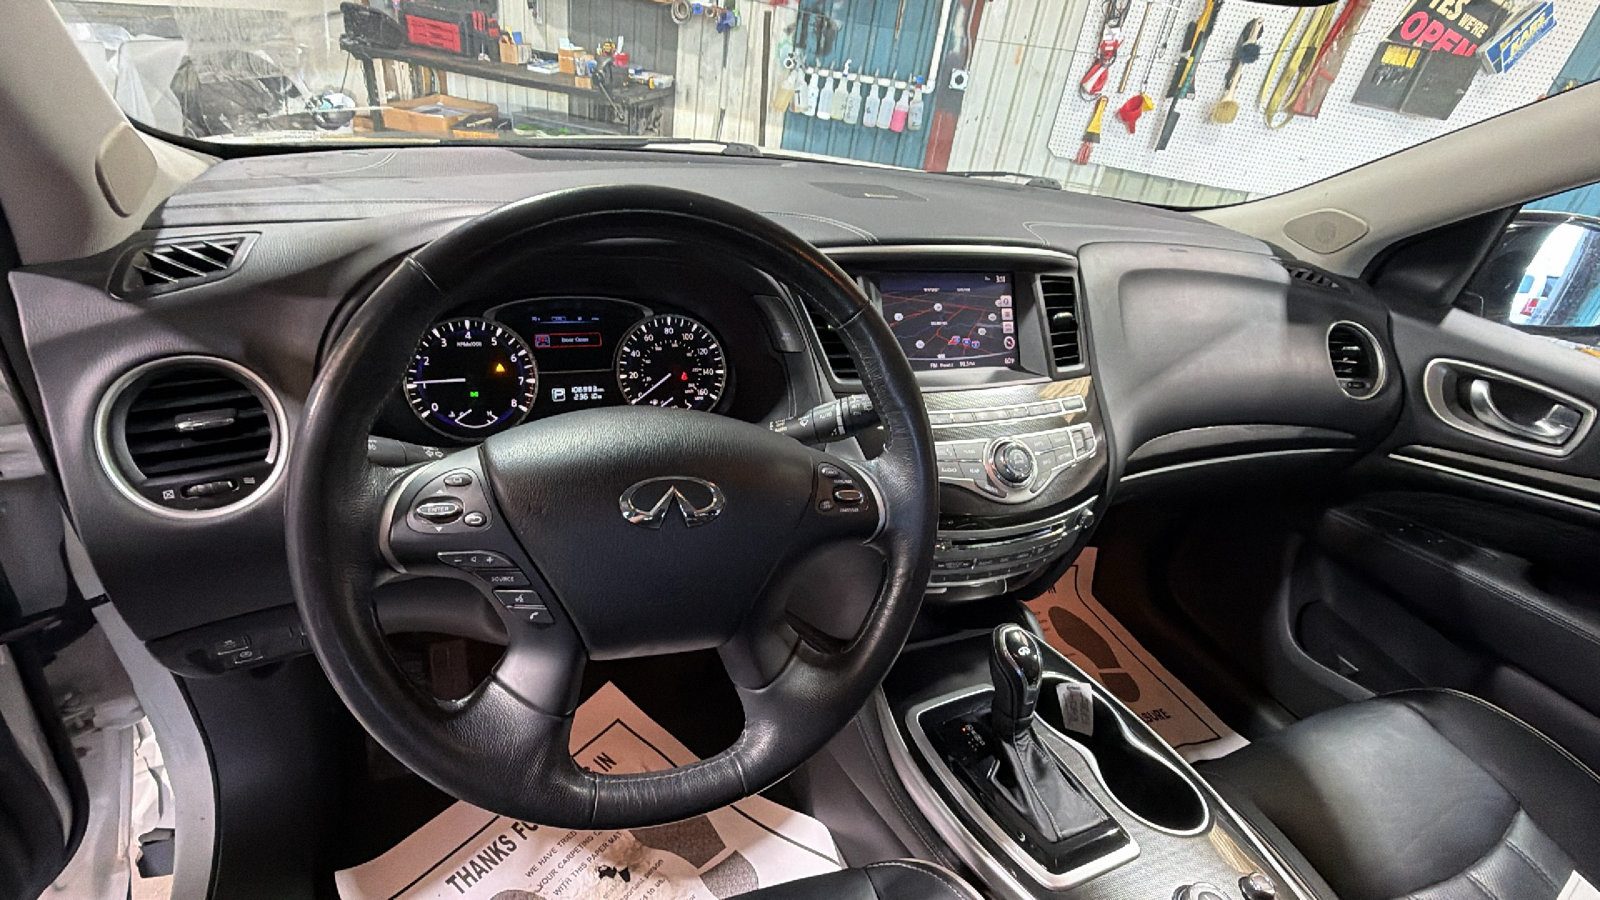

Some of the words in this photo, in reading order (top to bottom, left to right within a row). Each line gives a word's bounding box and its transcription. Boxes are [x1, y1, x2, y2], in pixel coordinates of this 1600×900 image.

[1458, 12, 1489, 39] WE'RE
[1400, 11, 1478, 57] OPEN
[464, 332, 472, 340] 4
[681, 333, 694, 341] 100
[441, 338, 447, 347] 3
[491, 337, 498, 346] 5
[510, 354, 518, 362] 6
[630, 350, 641, 358] 40
[423, 357, 430, 366] 2
[629, 371, 639, 379] 20
[518, 376, 524, 385] 7
[697, 388, 709, 396] 160
[431, 403, 439, 411] 0
[511, 399, 517, 407] 8
[445, 834, 518, 895] THANKS
[593, 751, 617, 772] IN
[525, 866, 539, 878] WE
[538, 850, 558, 867] HAVE
[557, 831, 578, 849] TRIED
[537, 869, 558, 892] YOUR
[558, 836, 595, 869] CARPETING
[552, 877, 573, 896] WITH
[571, 863, 588, 879] THIS
[586, 842, 609, 864] PAPER
